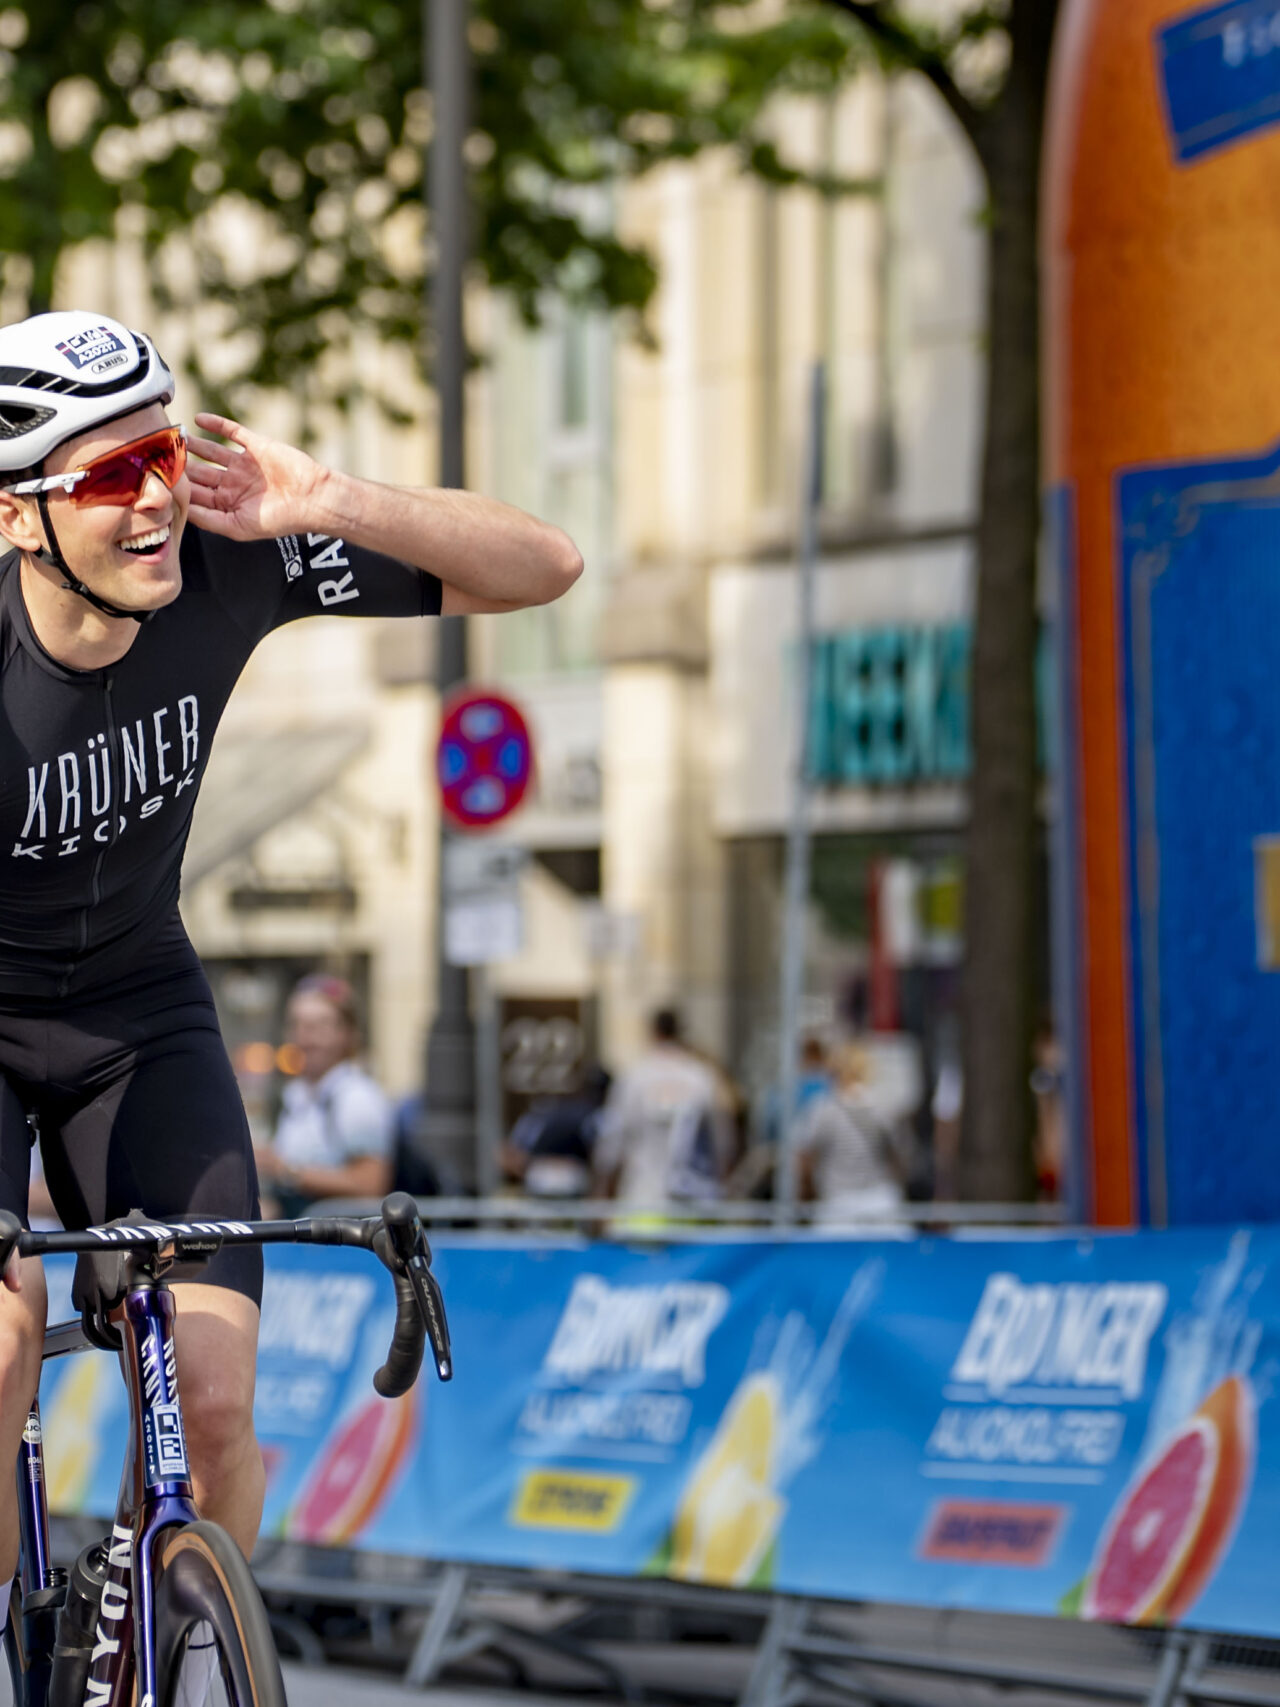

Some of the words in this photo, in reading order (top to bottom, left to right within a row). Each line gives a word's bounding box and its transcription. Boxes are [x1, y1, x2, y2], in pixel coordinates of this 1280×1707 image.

[20, 694, 199, 838] KRÜNER
[11, 768, 196, 860] KIOSK
[86, 1221, 254, 1242] CANYON
[182, 1242, 218, 1251] wahoo
